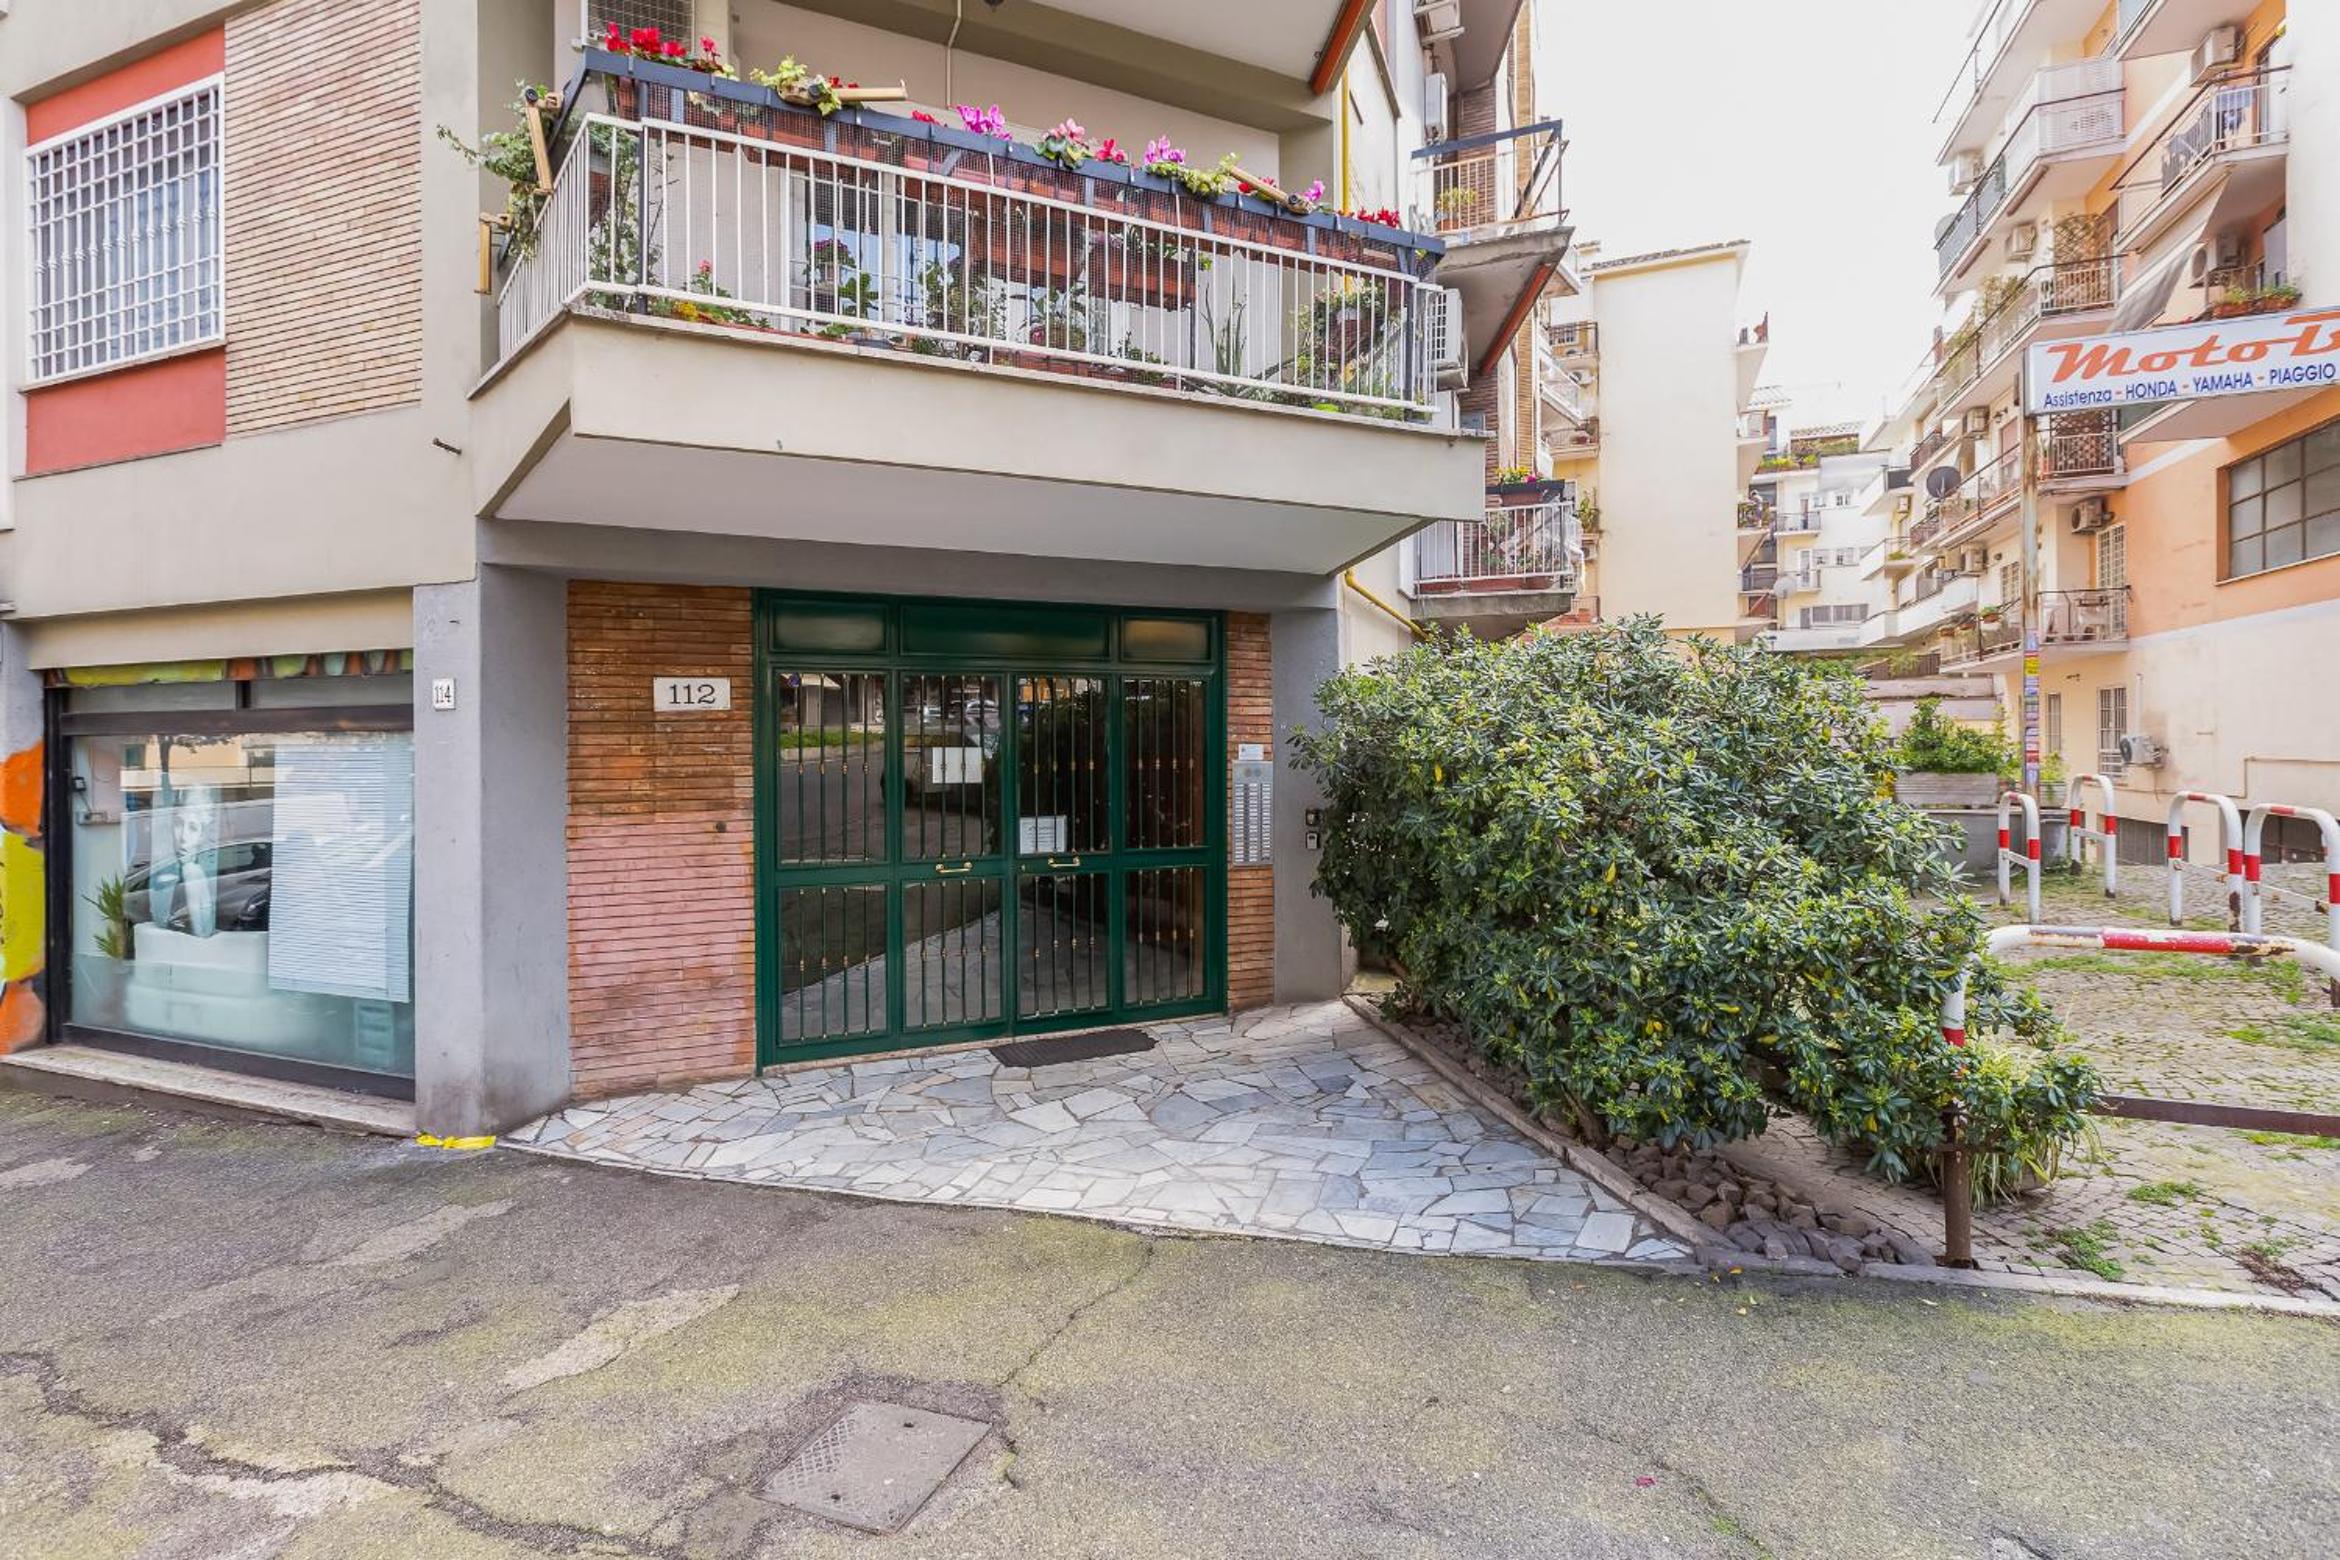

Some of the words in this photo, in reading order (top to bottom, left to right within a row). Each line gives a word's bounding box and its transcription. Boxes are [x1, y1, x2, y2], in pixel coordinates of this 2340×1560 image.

[2043, 389, 2112, 408] Assistenza
[2125, 380, 2177, 399] HONDA
[2193, 372, 2253, 392] YAMAHA
[2269, 363, 2336, 384] PIAGGIO
[434, 685, 452, 703] 114
[669, 684, 716, 704] 112
